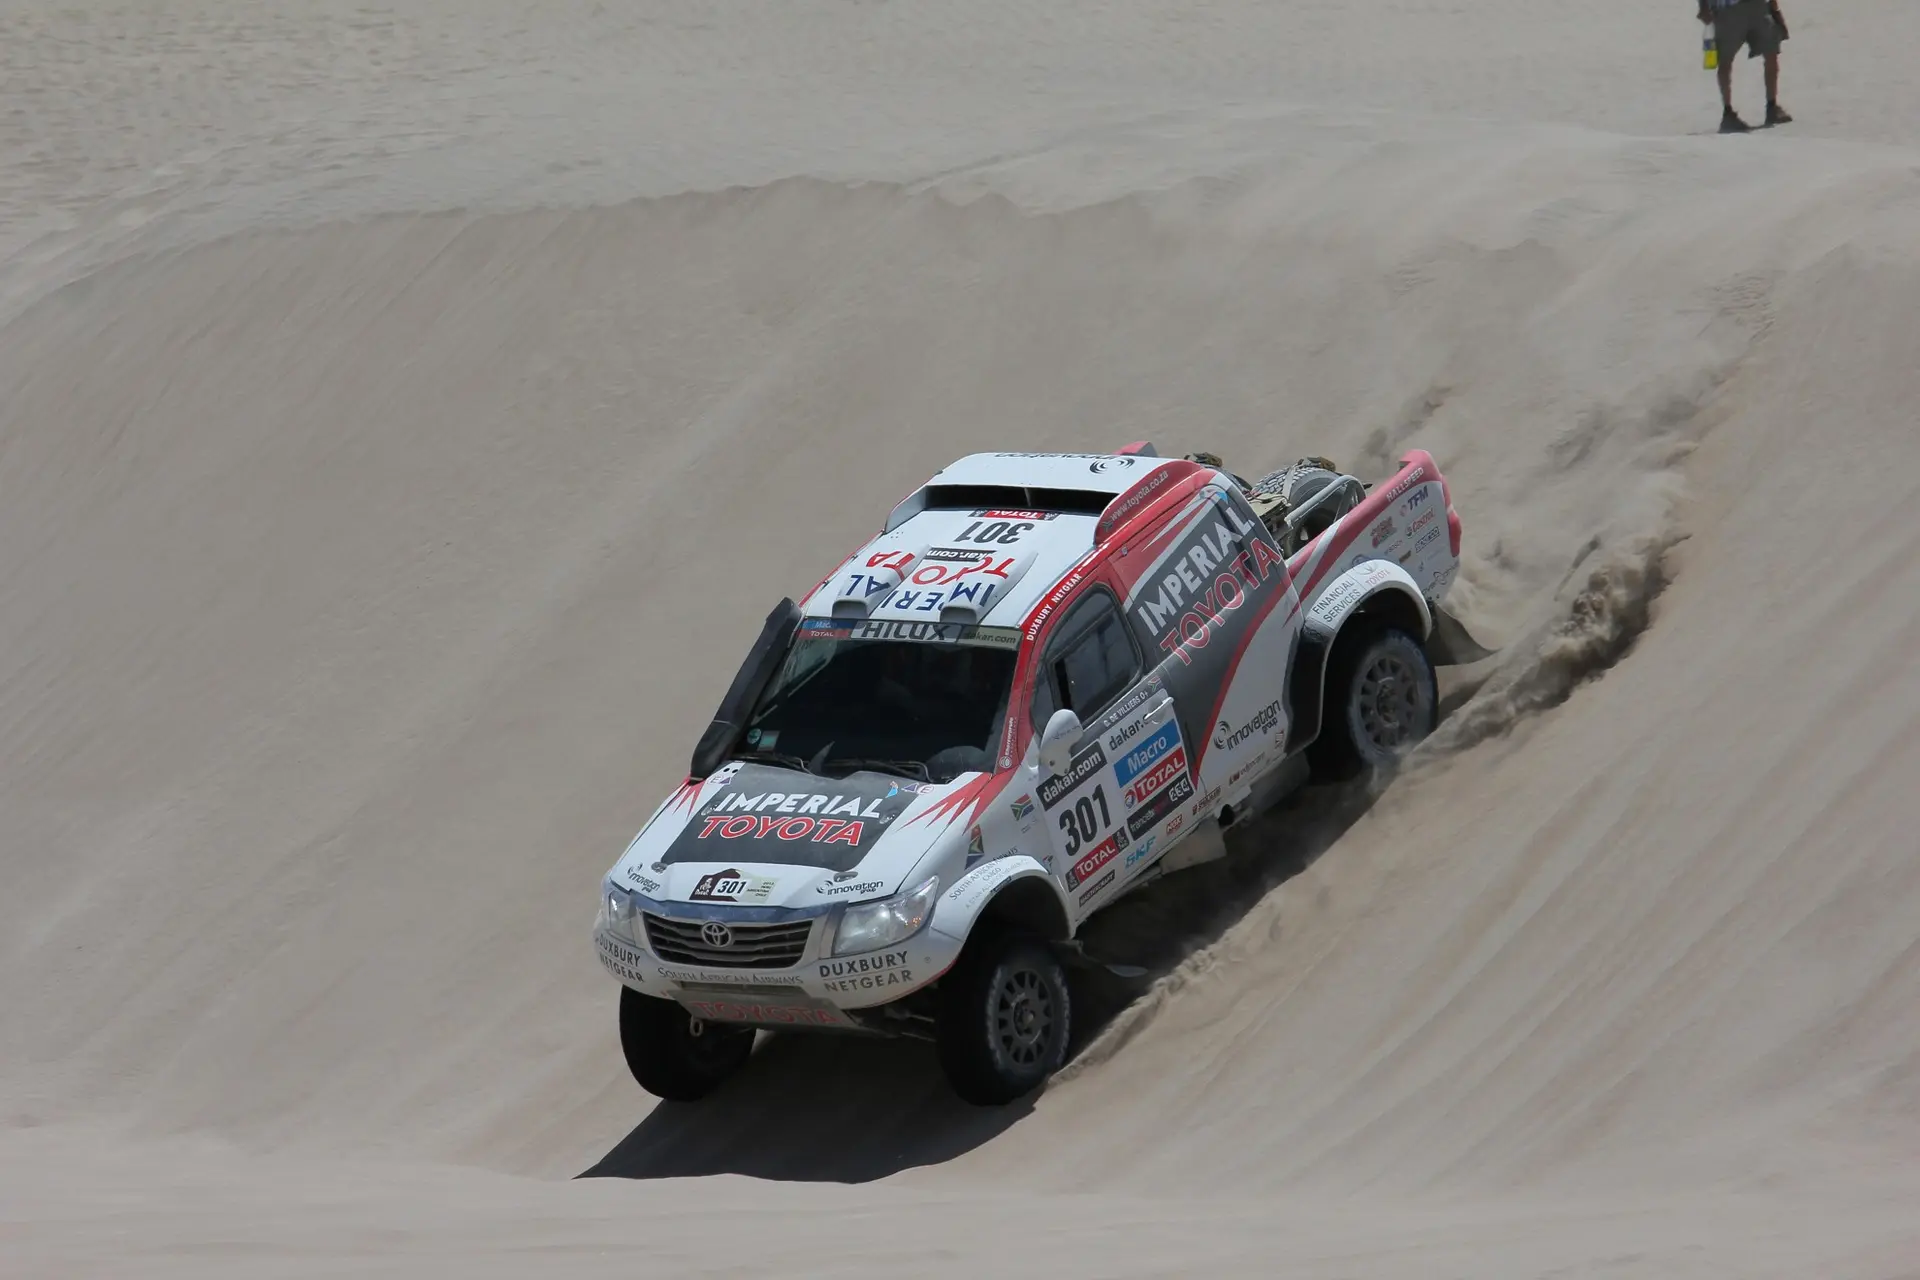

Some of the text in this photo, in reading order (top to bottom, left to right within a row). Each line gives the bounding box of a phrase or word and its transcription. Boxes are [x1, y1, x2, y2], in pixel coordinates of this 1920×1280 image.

[1110, 470, 1169, 521] www.toyota.co.za
[1407, 485, 1429, 511] TFM
[991, 510, 1041, 519] TOTAL
[953, 521, 1035, 544] 301
[926, 549, 988, 560] kar.com
[1138, 507, 1255, 637] IMPERIAL
[845, 574, 996, 611] IMERIAL
[1026, 573, 1082, 641] DUXBURY NETGEAR
[1159, 537, 1282, 667] TOYOTA
[1312, 580, 1355, 614] FINANCIAL
[1323, 588, 1362, 623] SERVICES
[861, 621, 951, 641] HILUX
[1109, 713, 1118, 723] DE
[1117, 695, 1141, 717] VILLIERS
[1226, 699, 1281, 751] innovation
[1261, 717, 1278, 735] group
[1127, 736, 1167, 775] Macro
[1043, 751, 1102, 802] dakar.com
[1137, 757, 1183, 797] TOTAL
[716, 792, 883, 819] IMPERIAL
[1058, 783, 1111, 856] 301
[698, 815, 864, 847] TOYOTA
[1076, 845, 1115, 877] TOTAL
[1125, 836, 1156, 869] SKF
[717, 880, 747, 894] 301
[827, 880, 884, 896] innovation
[949, 879, 971, 901] SOUTH
[599, 934, 641, 967] DUXBURY
[819, 951, 908, 978] DUXBURY
[657, 967, 804, 985] SOUTH AFRICAN AIRWAYS
[824, 969, 913, 993] NETGEAR
[693, 1001, 844, 1026] TOYOTA
